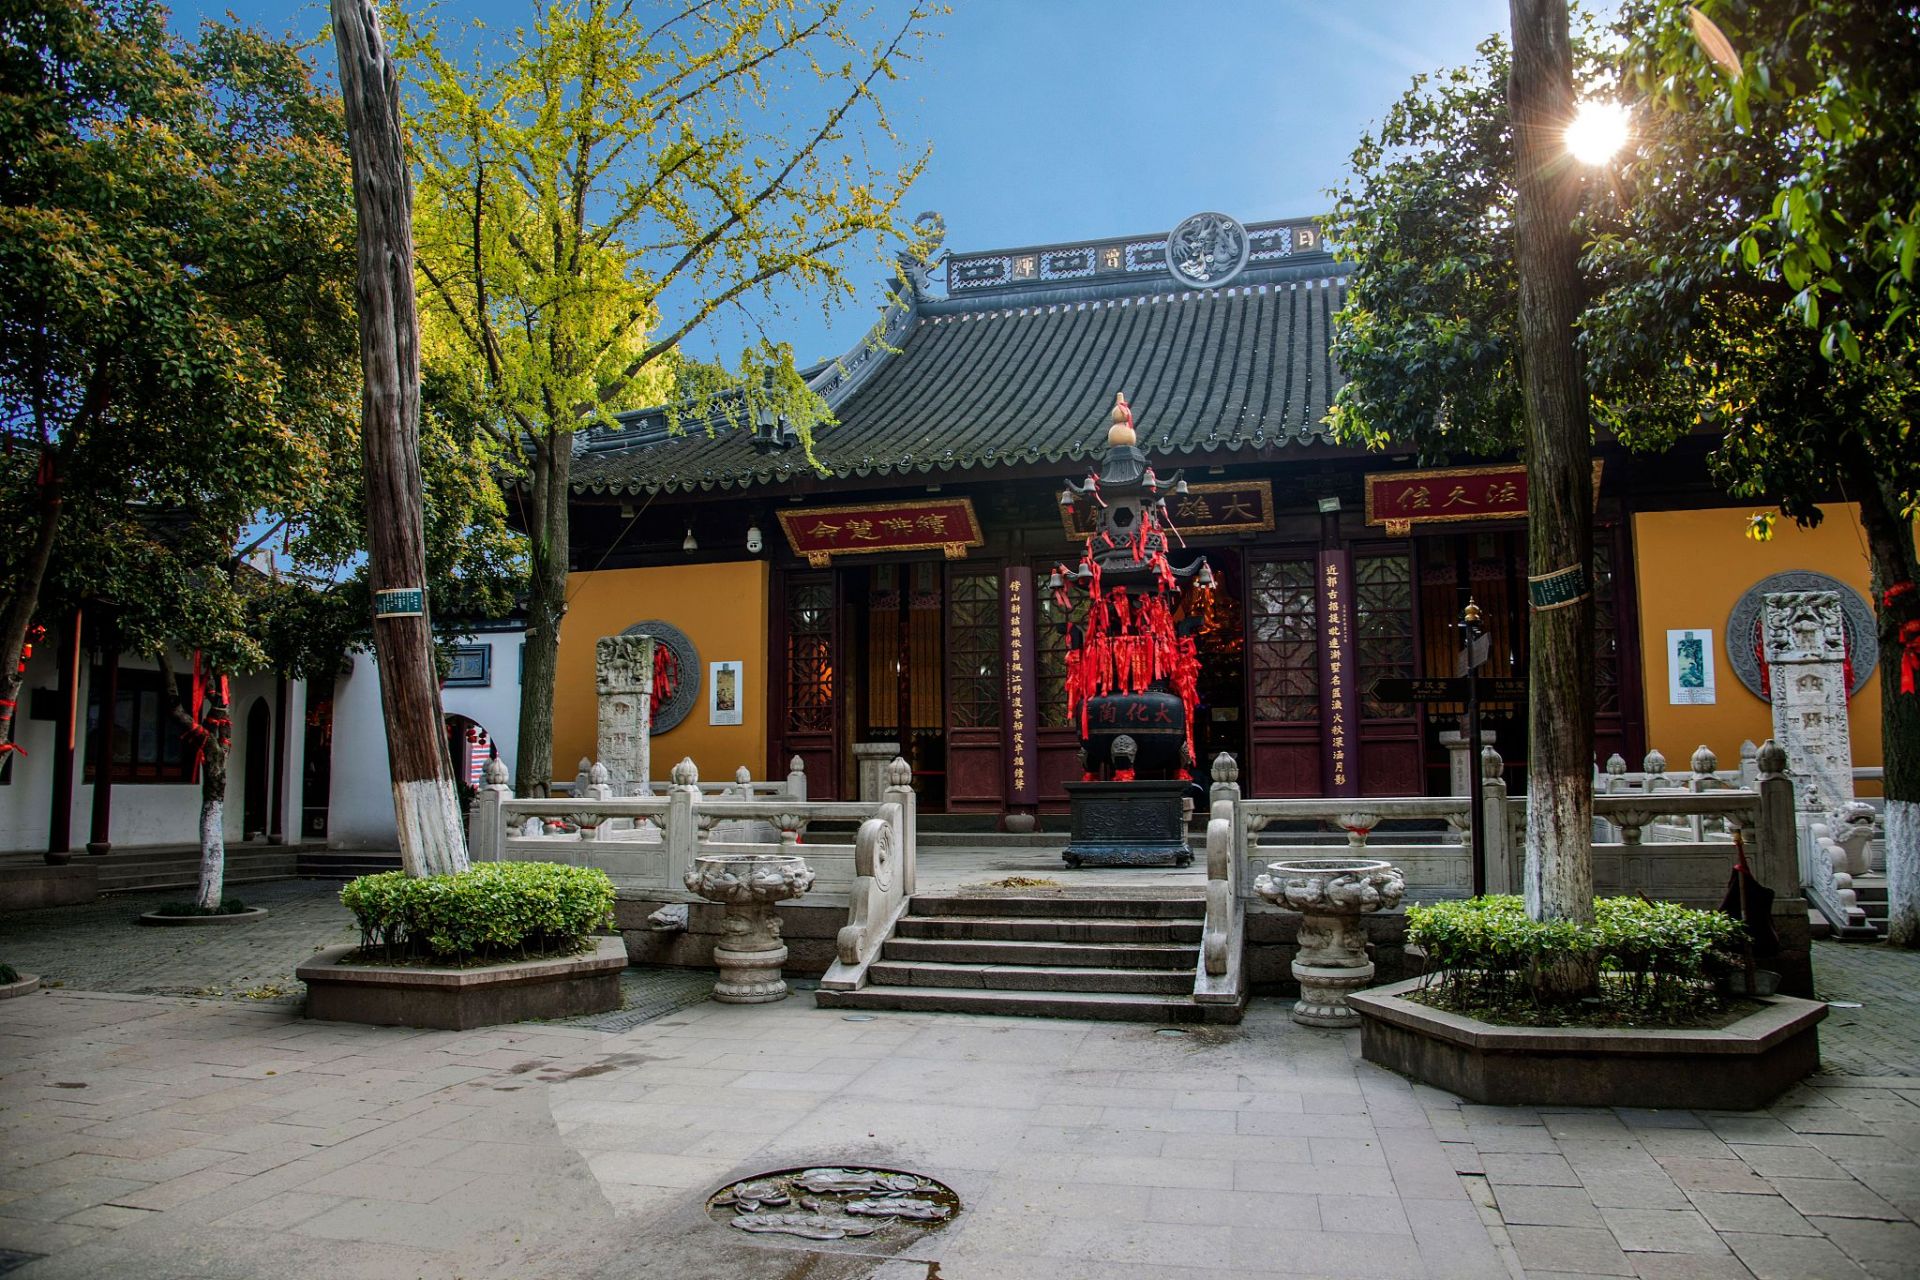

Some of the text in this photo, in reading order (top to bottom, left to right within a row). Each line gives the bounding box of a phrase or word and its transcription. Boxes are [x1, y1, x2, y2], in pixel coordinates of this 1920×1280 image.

[1396, 480, 1520, 510] 法久住
[1086, 494, 1258, 528] 大雄
[1087, 701, 1175, 724] 大化陶
